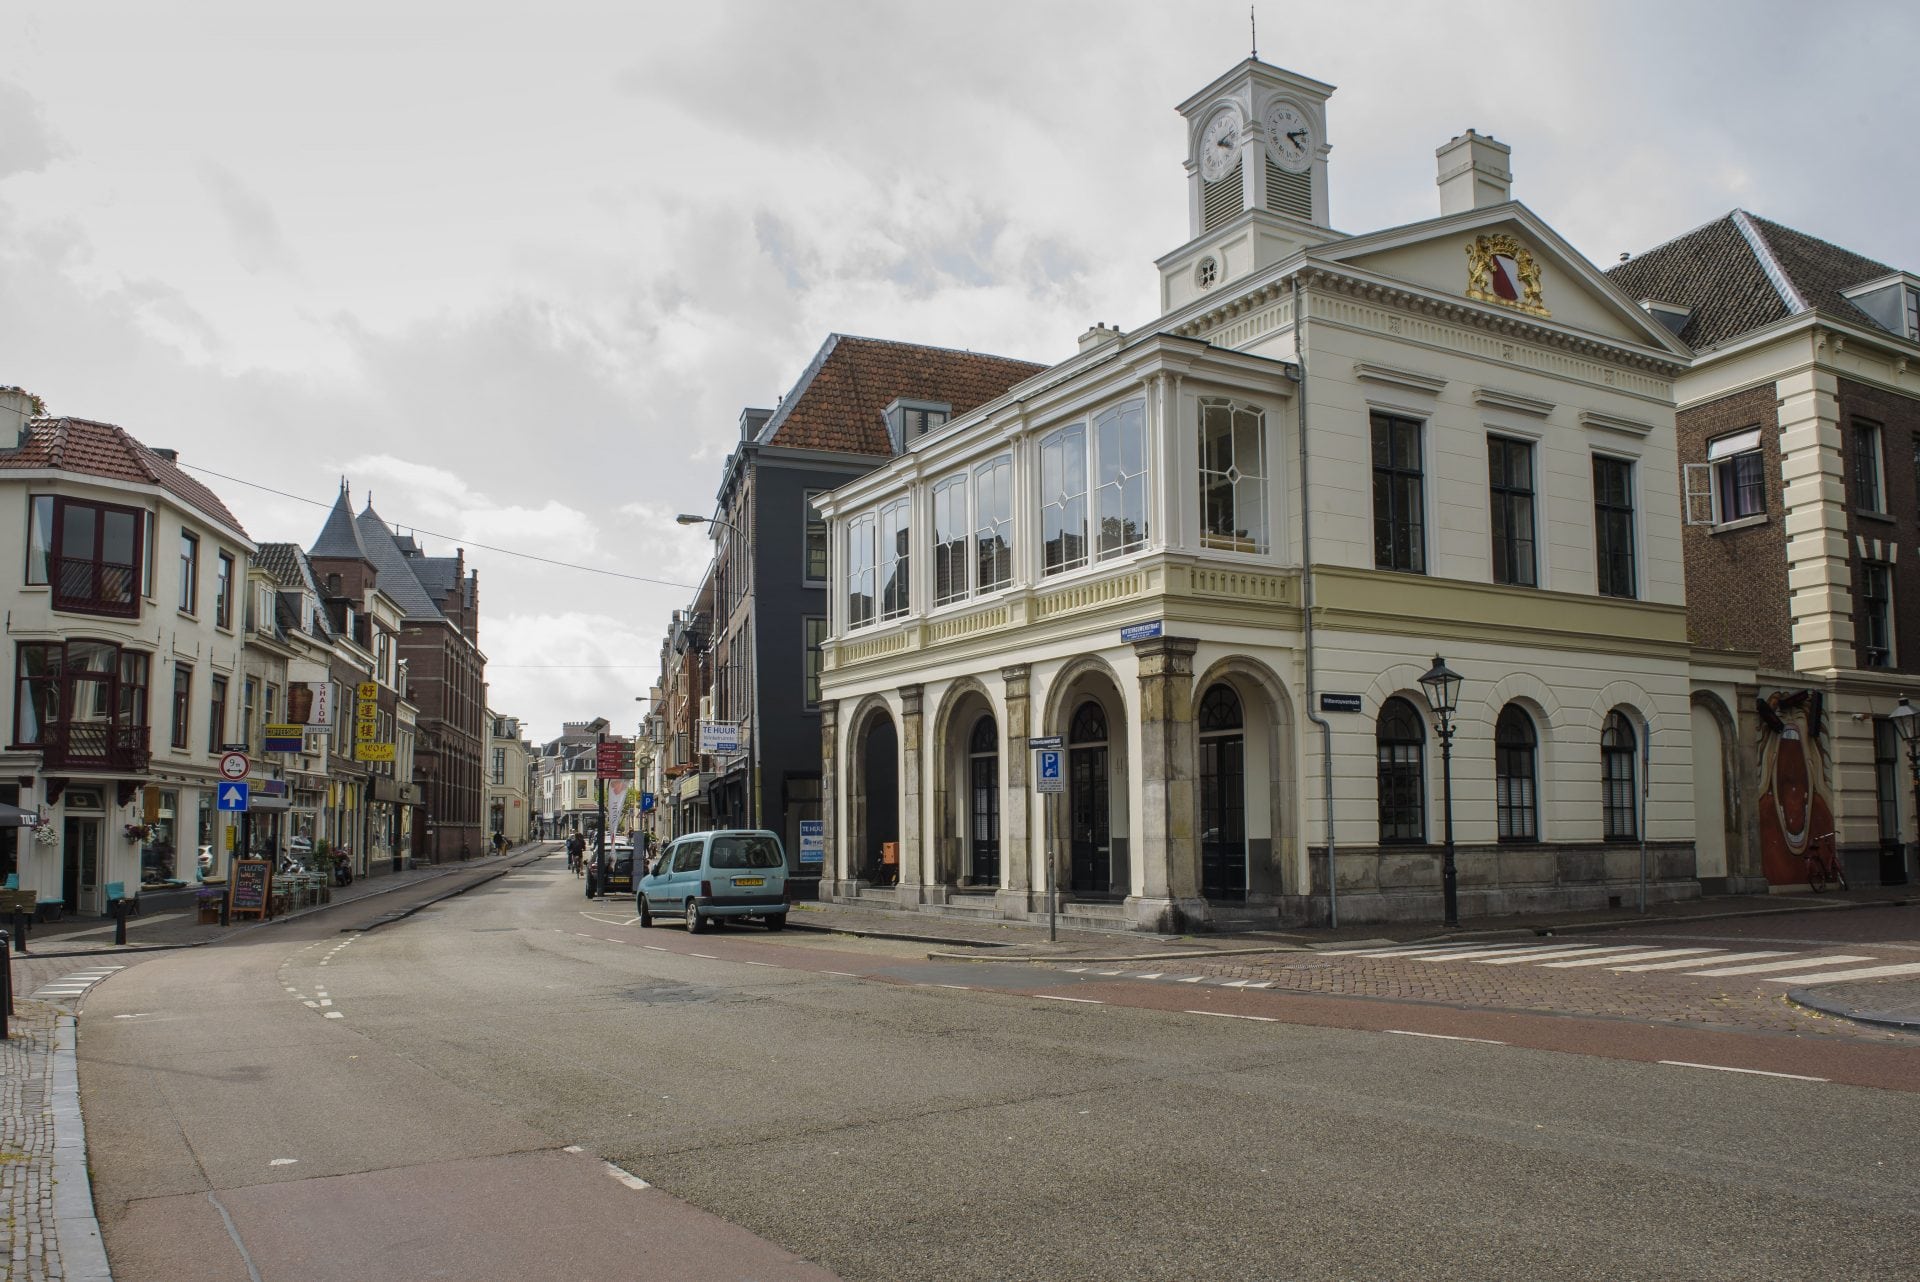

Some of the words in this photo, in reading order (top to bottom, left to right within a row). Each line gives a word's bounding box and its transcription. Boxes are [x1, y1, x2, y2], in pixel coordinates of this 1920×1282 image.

[317, 683, 326, 724] SHALOM
[266, 728, 302, 736] COFFEESHOP
[1046, 754, 1055, 767] P
